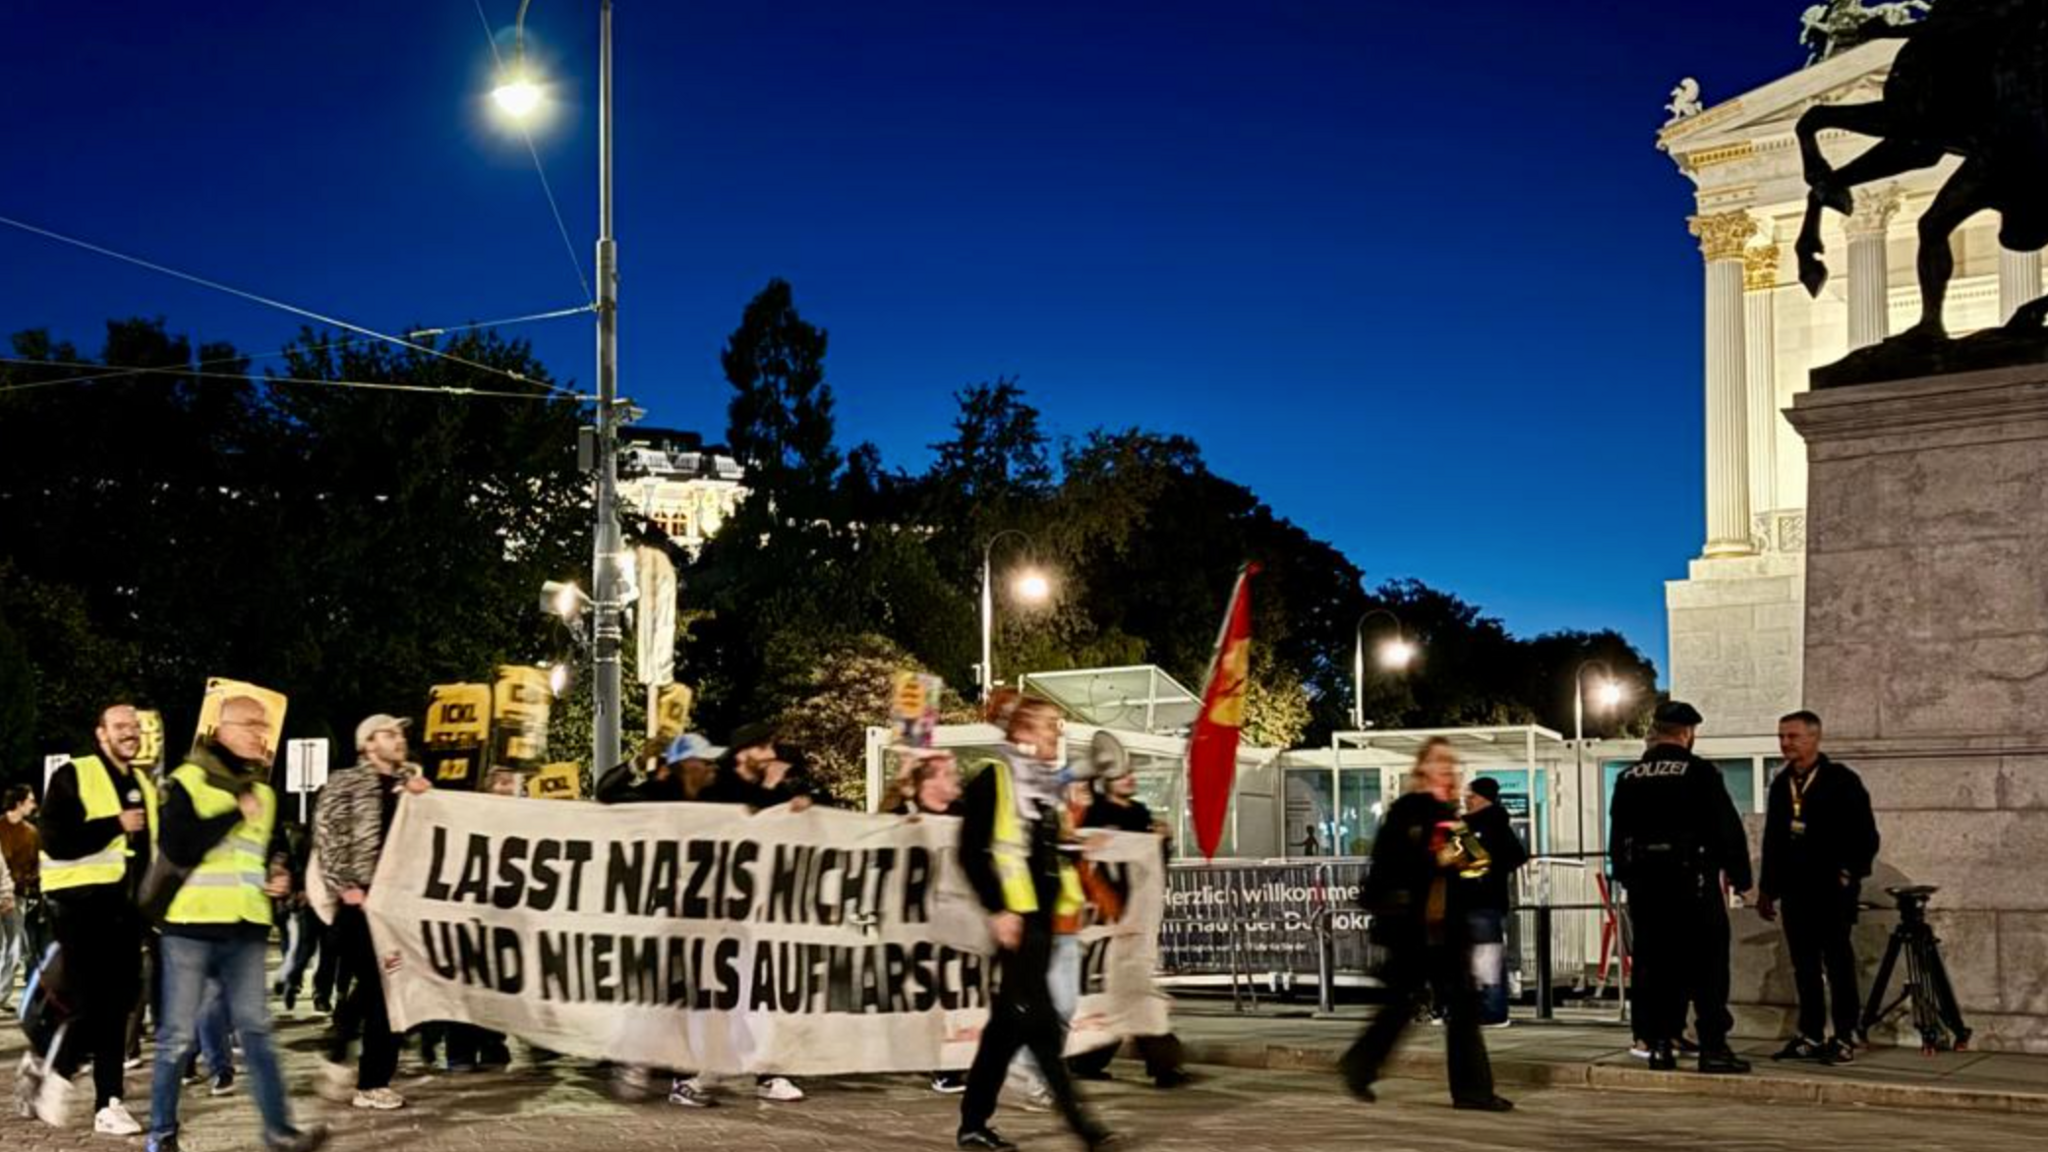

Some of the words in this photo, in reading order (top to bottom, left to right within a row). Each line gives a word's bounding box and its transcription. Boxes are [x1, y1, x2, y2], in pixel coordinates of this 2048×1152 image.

[423, 825, 593, 912] LASST
[603, 839, 760, 921] NAZIS
[766, 844, 896, 926] NICHT
[1242, 883, 1364, 903] willkomme
[420, 918, 525, 995] UND
[537, 930, 741, 1012] NIEMALS
